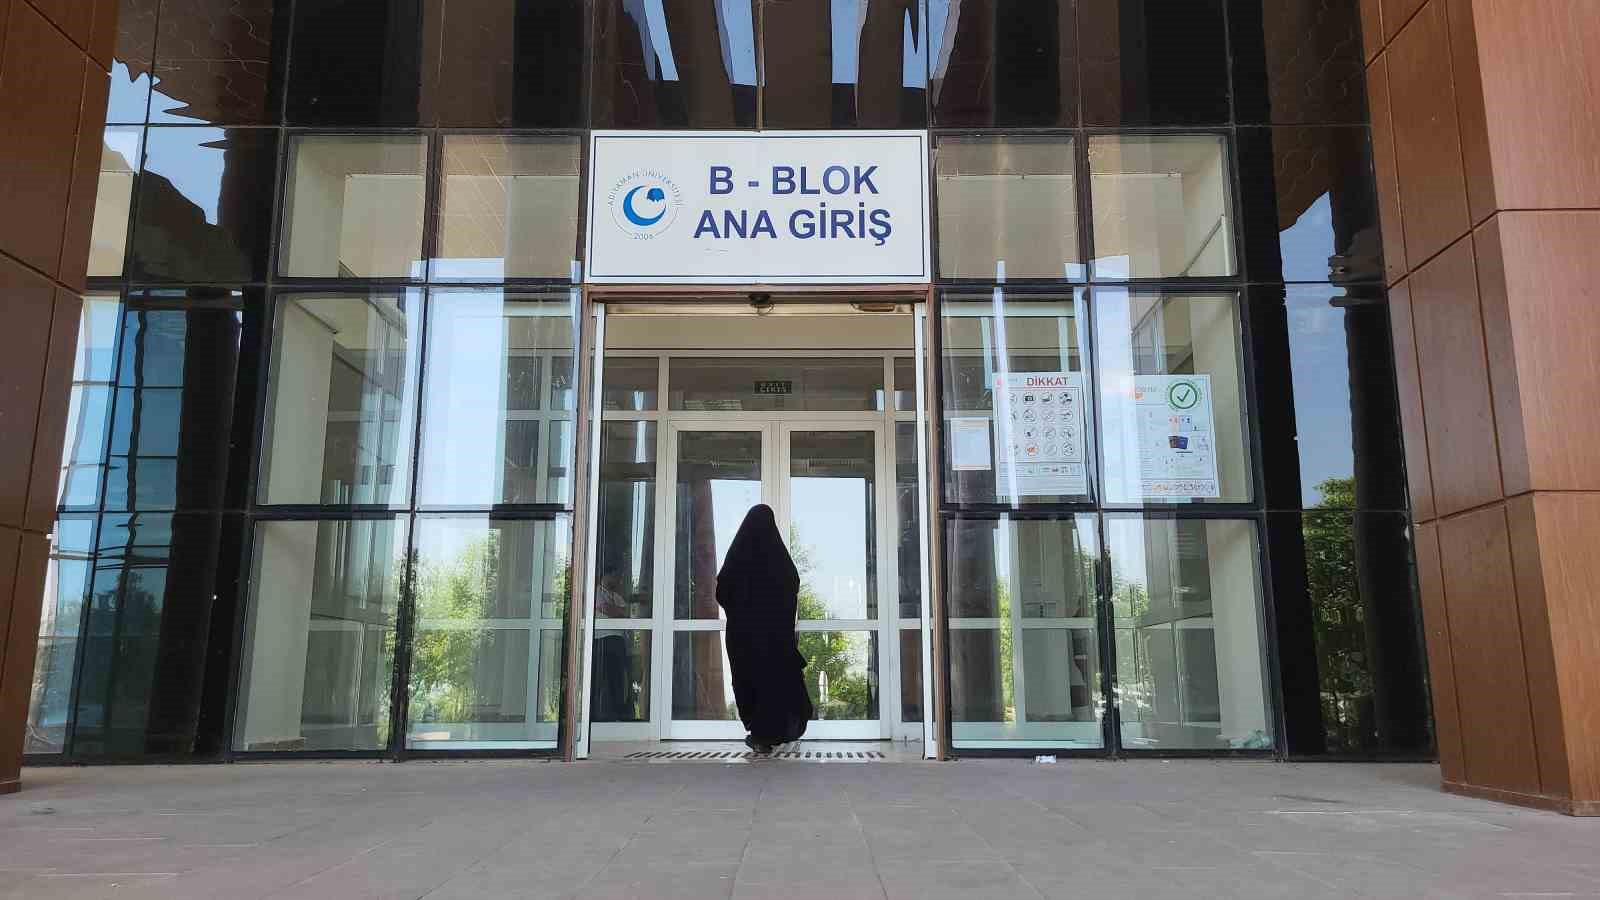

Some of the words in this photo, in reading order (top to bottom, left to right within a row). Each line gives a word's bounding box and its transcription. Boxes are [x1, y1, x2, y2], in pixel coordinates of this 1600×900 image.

[709, 165, 734, 194] B
[772, 165, 879, 195] BLOK
[693, 209, 777, 239] ANA
[788, 202, 892, 246] GİRİŞ
[1026, 375, 1068, 386] DİKKAT
